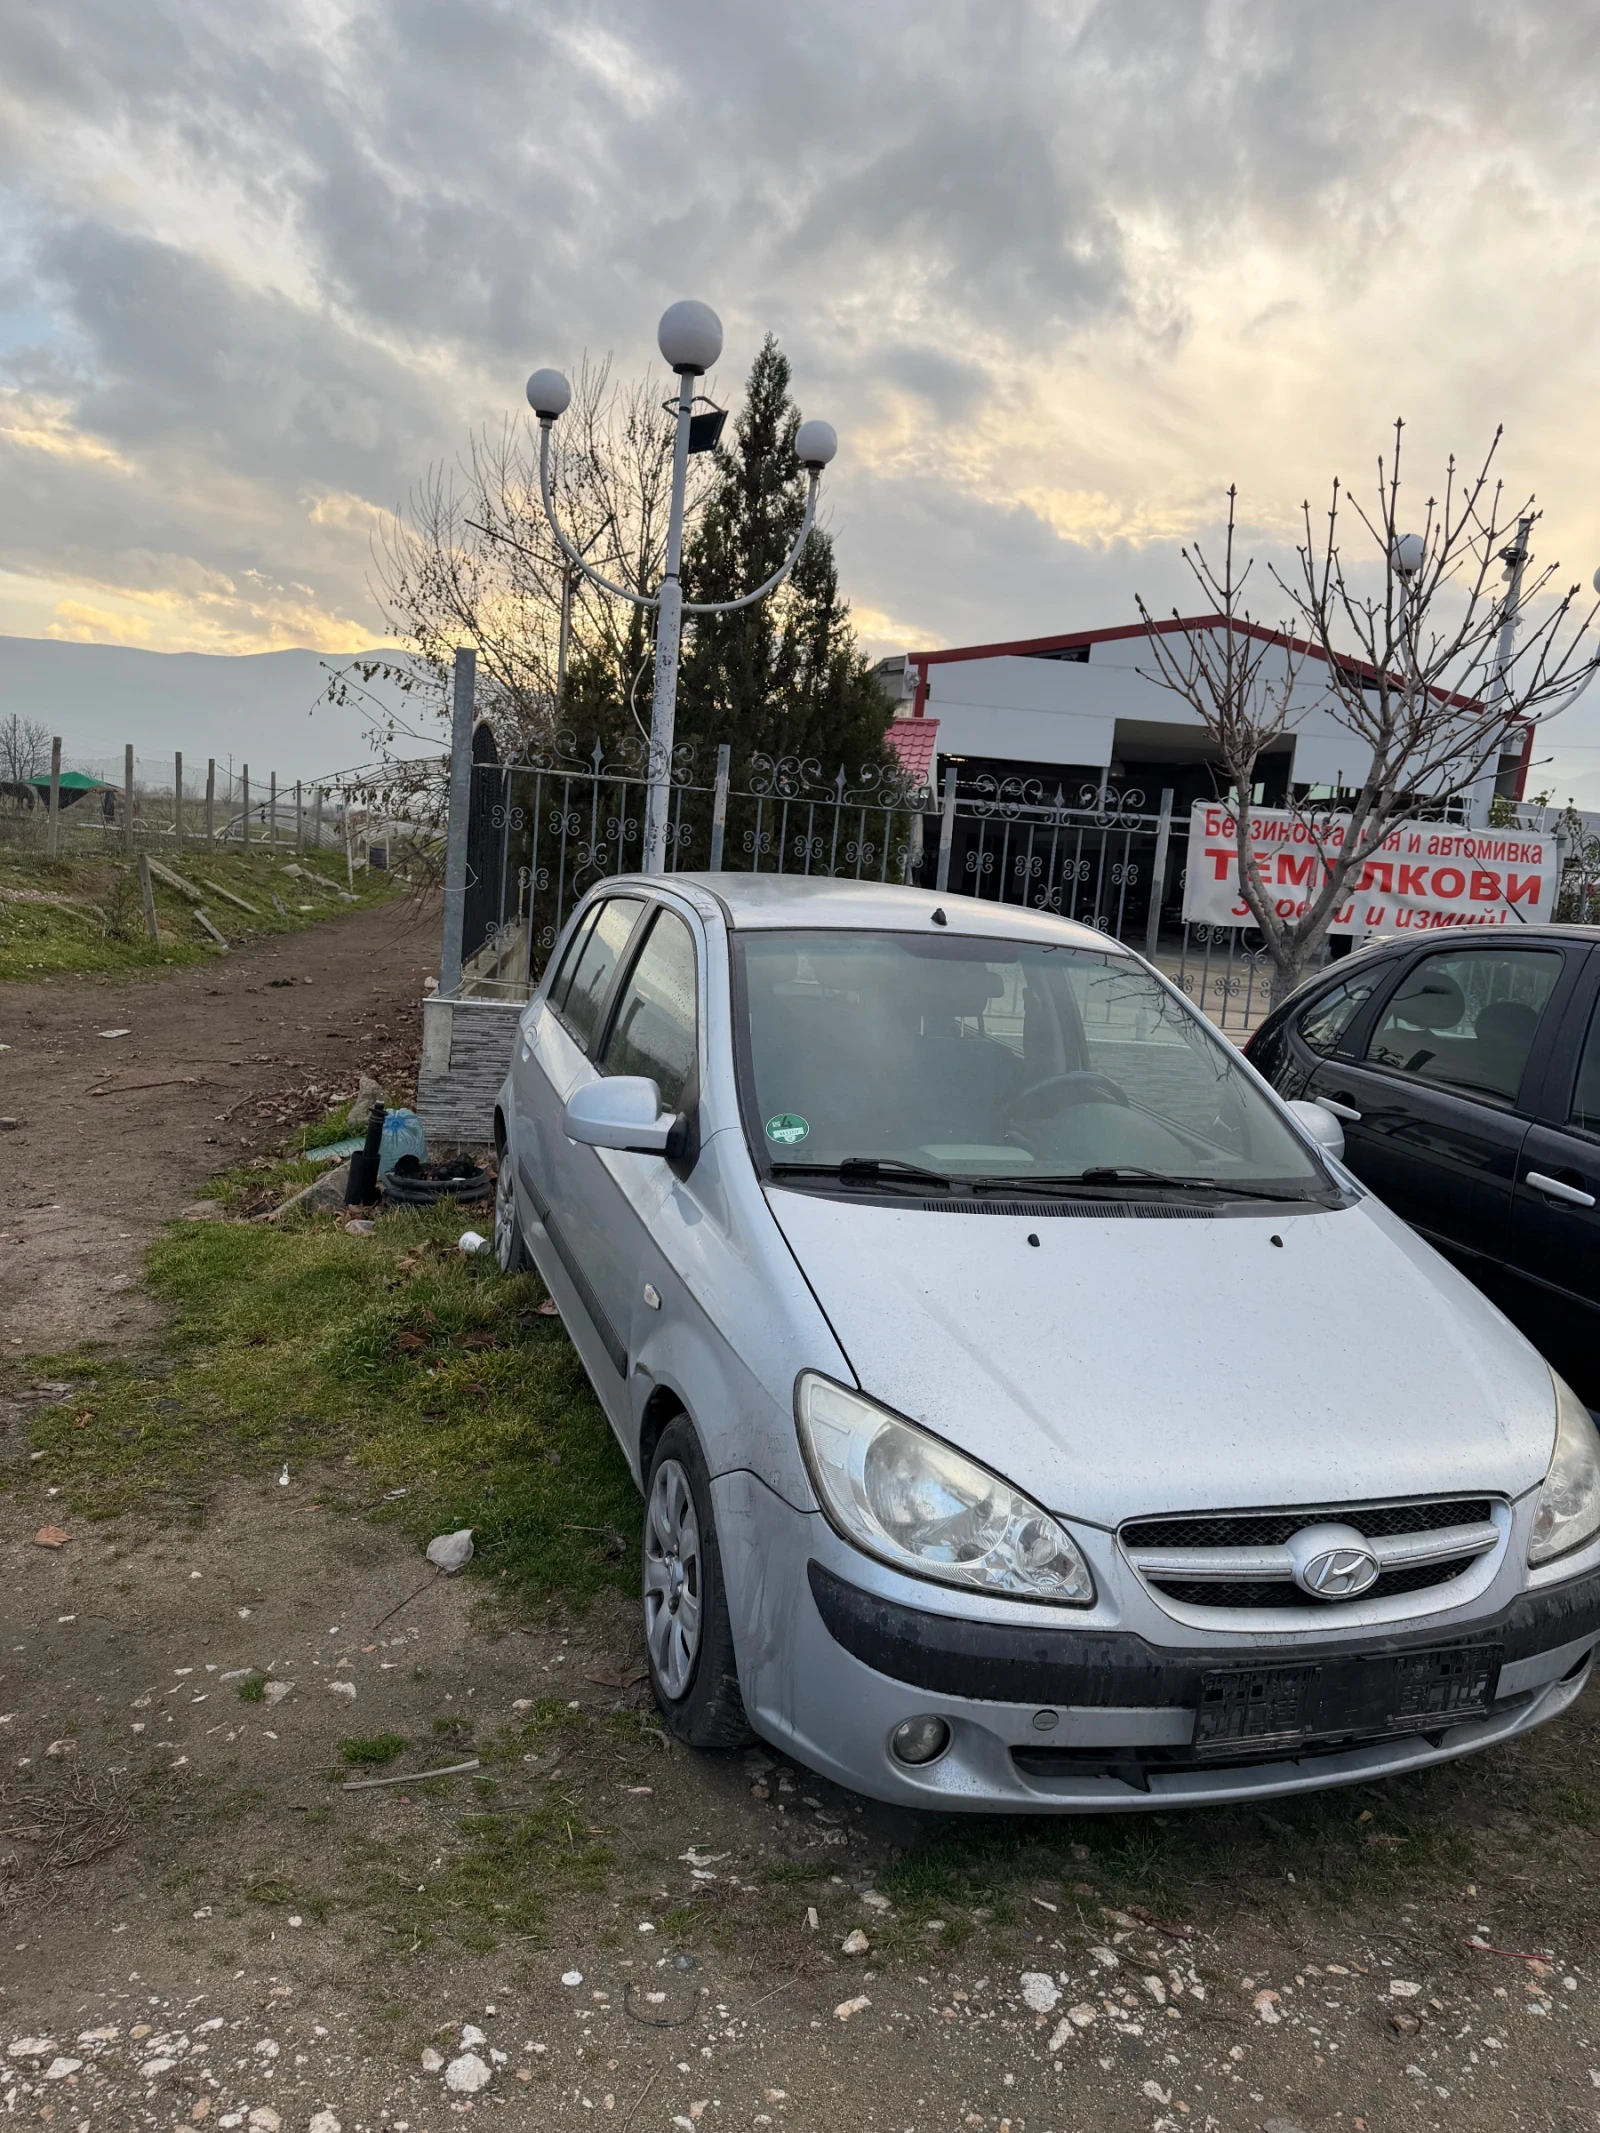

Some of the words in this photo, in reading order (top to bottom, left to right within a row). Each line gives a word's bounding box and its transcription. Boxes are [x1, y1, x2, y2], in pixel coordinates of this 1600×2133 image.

[1205, 808, 1401, 853] Безиностая
[1408, 833, 1421, 853] и
[1427, 834, 1543, 865] автомивка
[1231, 895, 1355, 924] Зреи
[1365, 905, 1385, 926] и
[780, 1115, 793, 1129] 4
